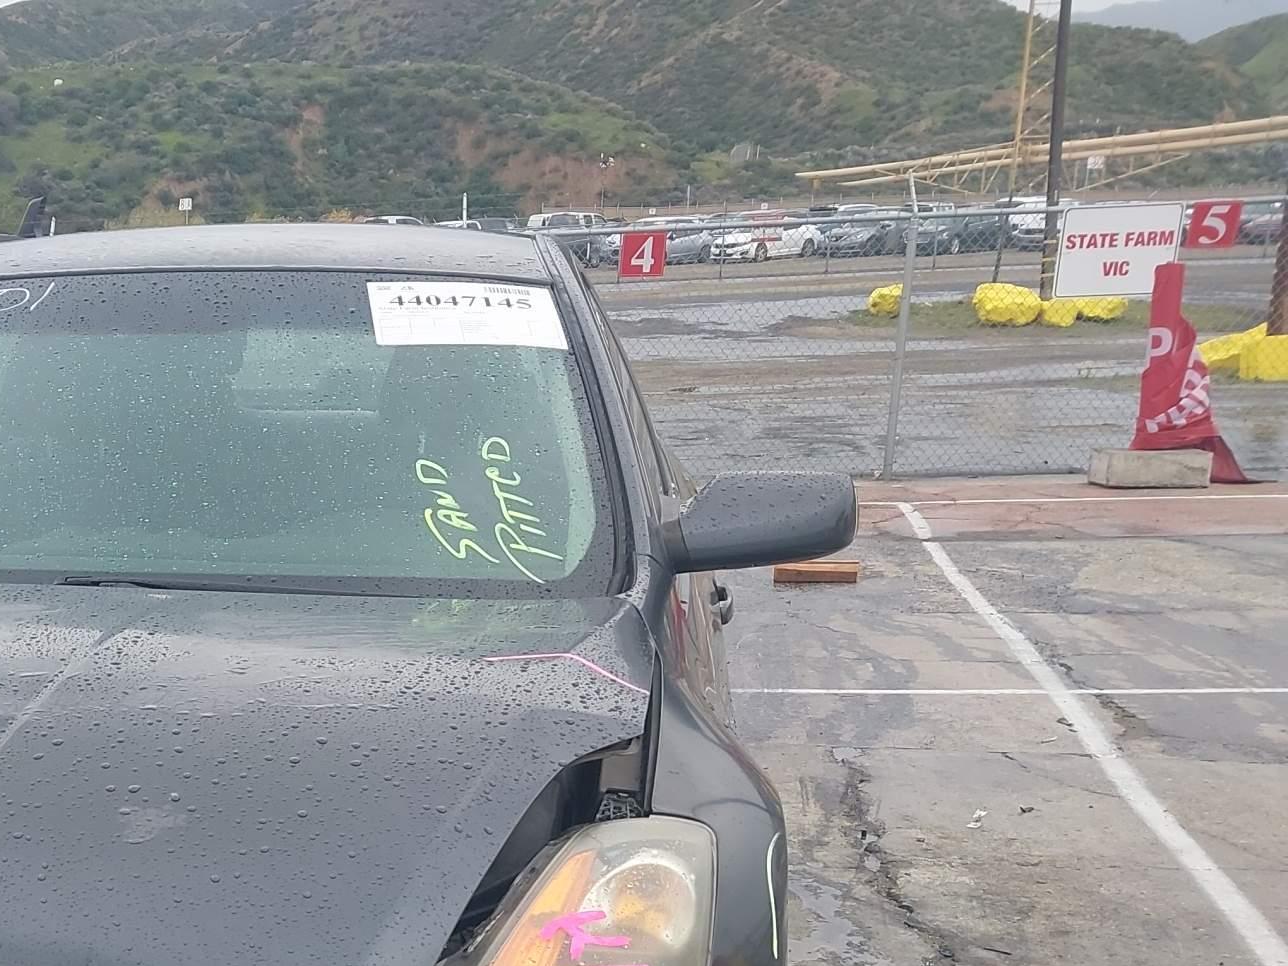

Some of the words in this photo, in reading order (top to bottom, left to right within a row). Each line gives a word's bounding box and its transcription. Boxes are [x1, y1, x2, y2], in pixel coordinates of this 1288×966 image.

[1197, 205, 1231, 244] 5
[1065, 232, 1120, 250] STATE
[1124, 230, 1175, 247] FARM
[630, 236, 655, 273] 4
[1102, 261, 1131, 277] VIC
[388, 294, 532, 310] 44047145
[415, 458, 501, 564] SAND
